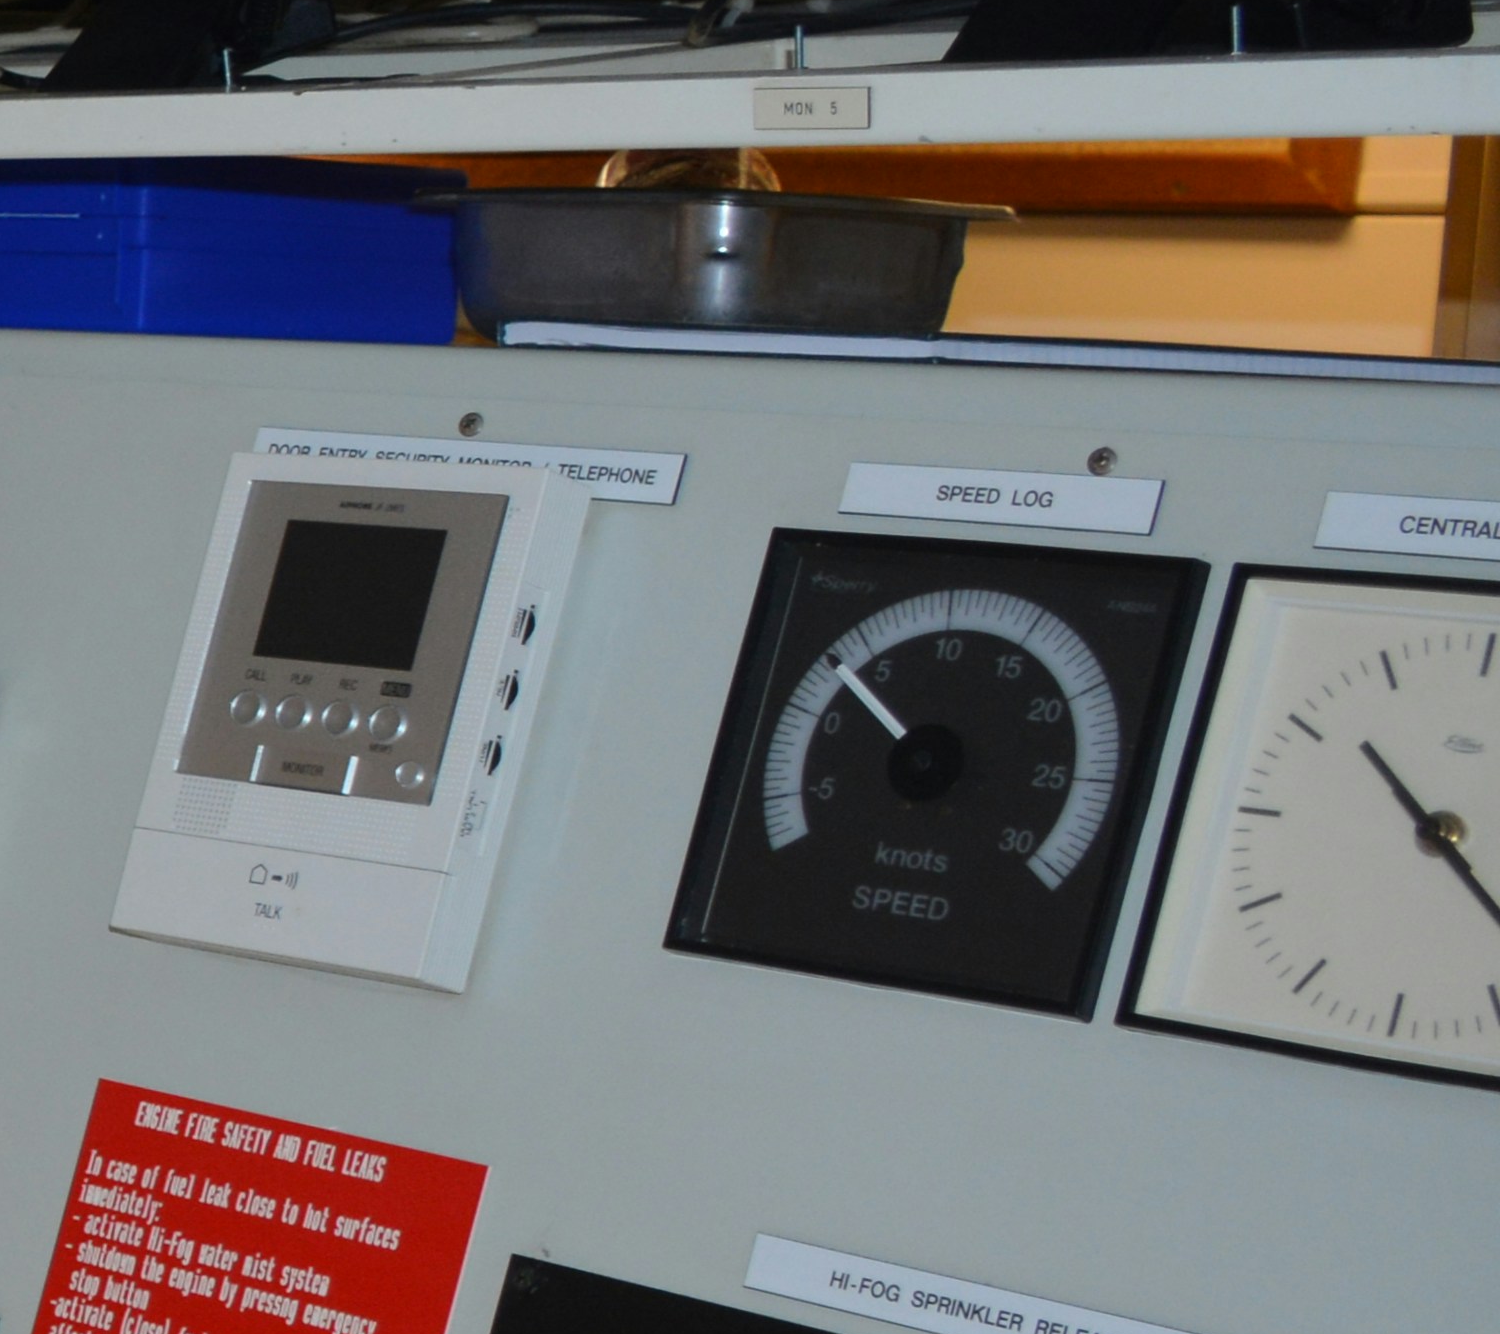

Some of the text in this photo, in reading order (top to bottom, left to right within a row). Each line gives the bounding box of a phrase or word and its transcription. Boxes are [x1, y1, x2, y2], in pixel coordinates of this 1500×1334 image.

[784, 101, 837, 115] MON 5
[557, 463, 658, 485] TELEPHONE
[935, 485, 1054, 508] SPEED LOG
[1399, 516, 1500, 539] CENTRAL
[935, 638, 963, 661] 10
[874, 659, 892, 683] 5
[995, 655, 1022, 680] 15
[1026, 698, 1063, 723] 20
[824, 713, 841, 735] 0
[808, 777, 836, 801] -5
[1031, 765, 1066, 790] 25
[999, 829, 1034, 854] 30
[874, 842, 949, 874] knots
[254, 902, 283, 919] TALK
[852, 886, 950, 922] SPEED
[134, 1100, 387, 1183] ENGINE FIRE SAFETY AND FUEL LEAKS
[85, 1149, 401, 1251] In case of fuel leak close to hot surfaces
[83, 1212, 331, 1297] activate Hi-Fog water mist system
[69, 1268, 150, 1311] stop button
[76, 1243, 136, 1275] shutdown
[140, 1257, 165, 1283] the
[168, 1267, 216, 1299] engine
[219, 1277, 239, 1307] by
[240, 1286, 299, 1325] pressng
[829, 1270, 901, 1303] HI-FOG
[911, 1290, 1024, 1333] SPRINKLER
